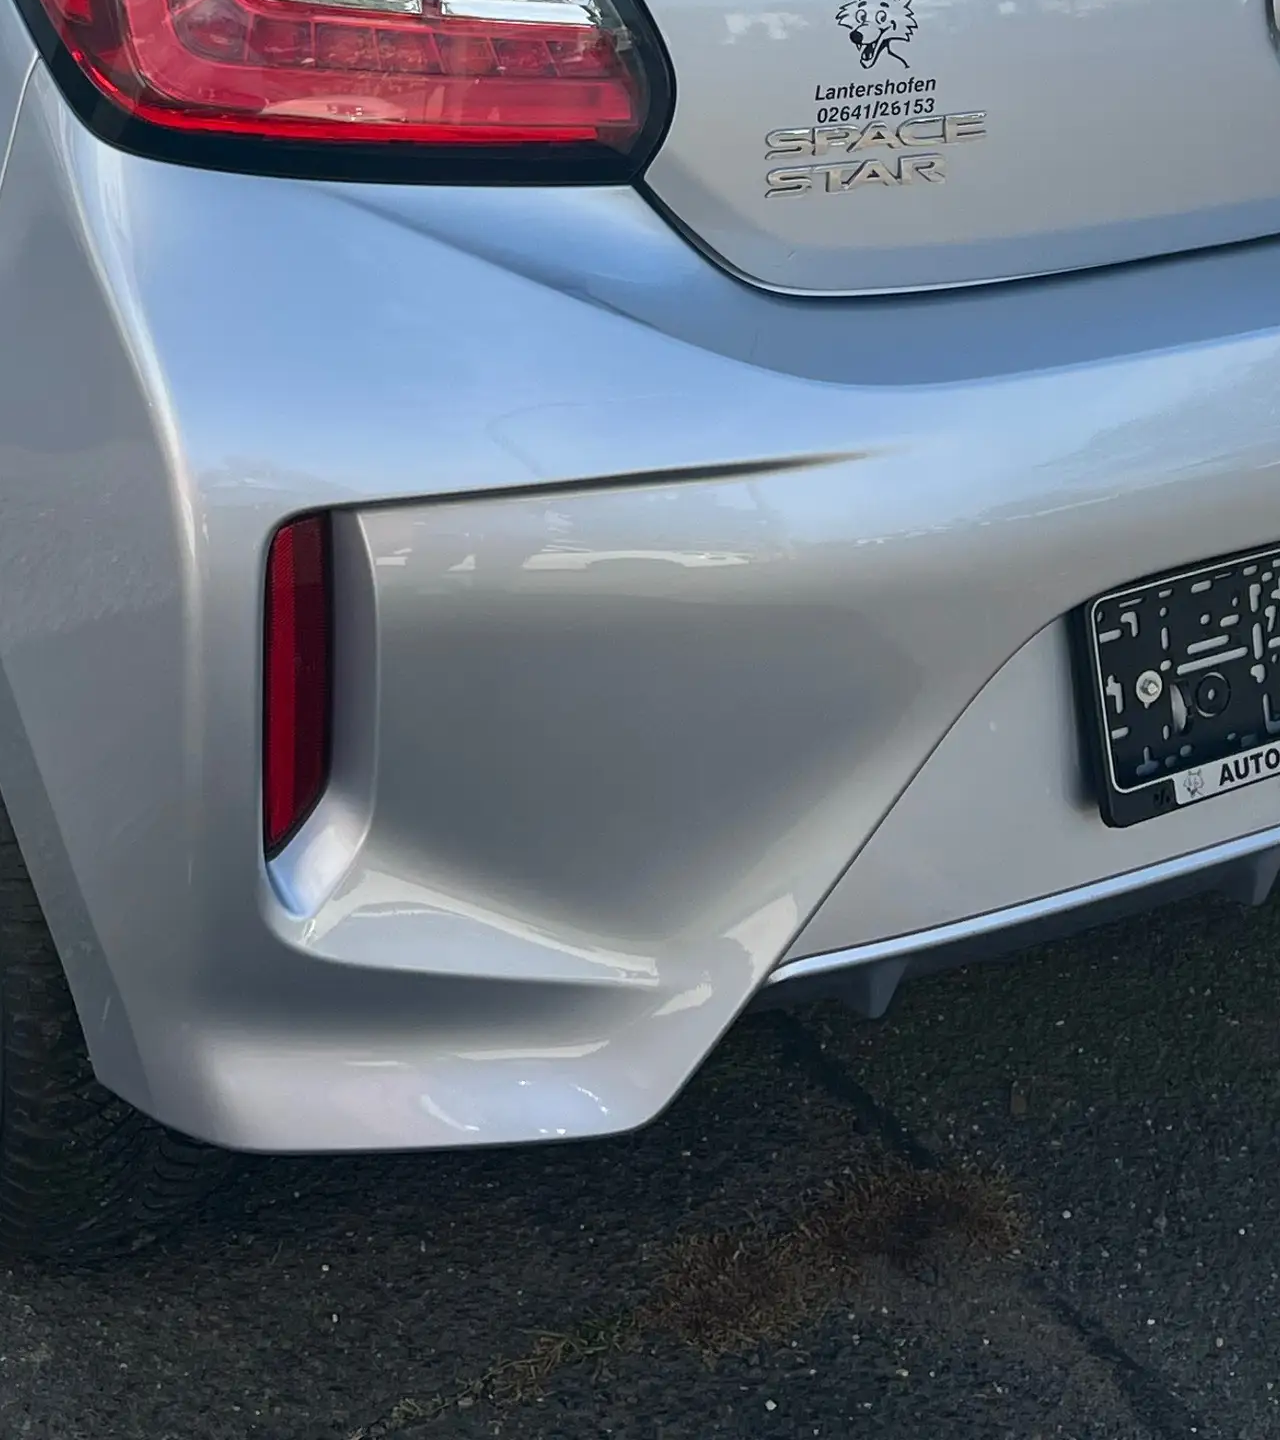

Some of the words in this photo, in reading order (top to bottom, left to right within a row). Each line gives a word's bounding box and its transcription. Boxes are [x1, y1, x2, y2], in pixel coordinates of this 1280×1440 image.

[815, 77, 937, 101] Lantershofen
[765, 110, 987, 160] SPACE
[765, 153, 946, 198] STAR
